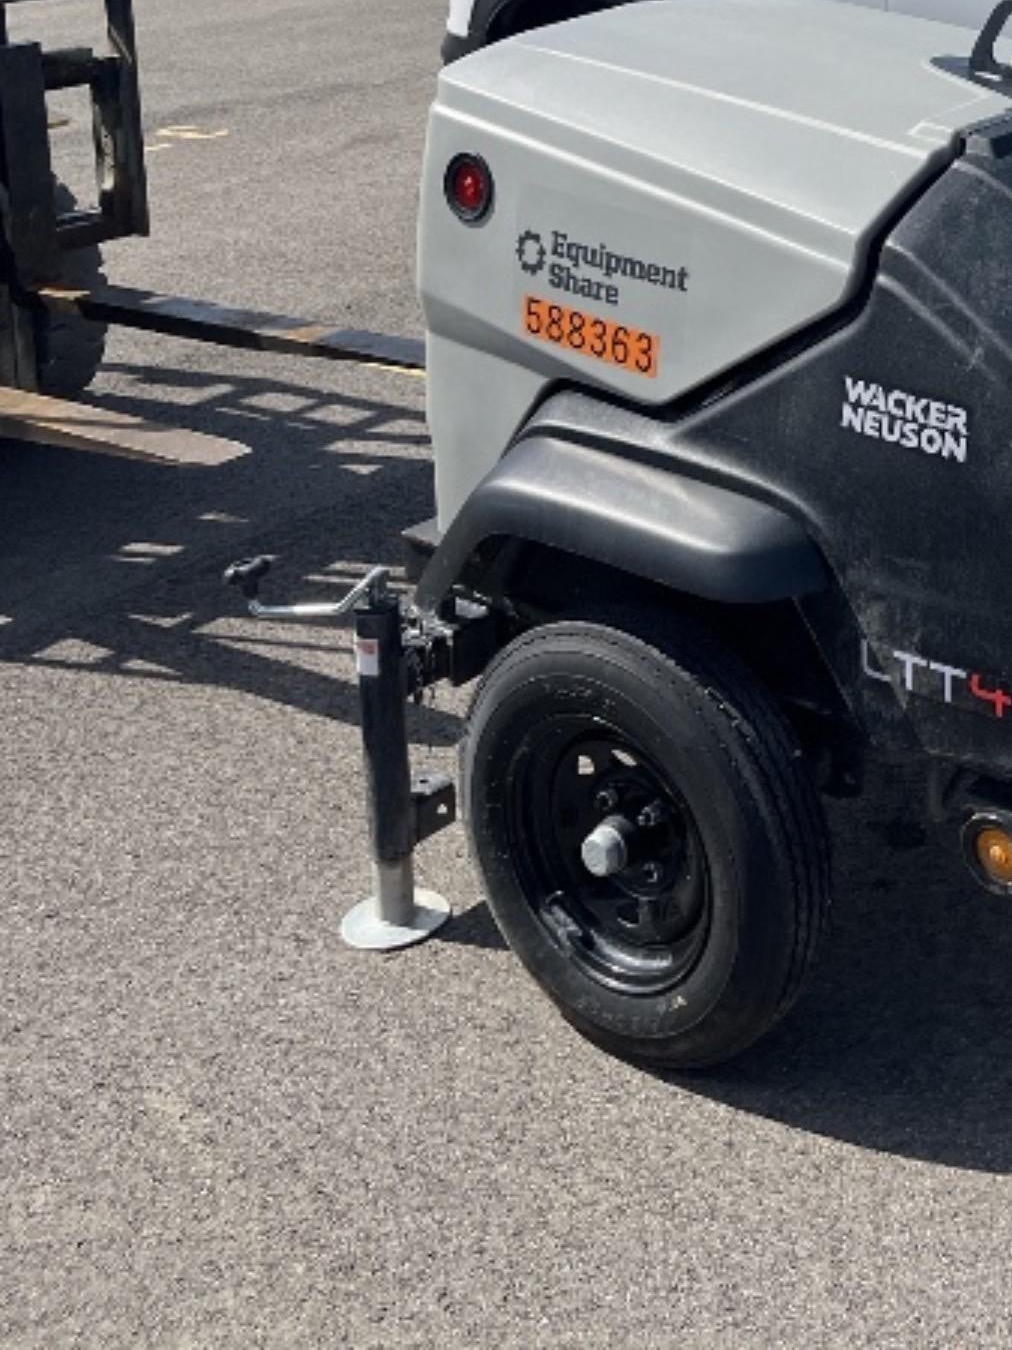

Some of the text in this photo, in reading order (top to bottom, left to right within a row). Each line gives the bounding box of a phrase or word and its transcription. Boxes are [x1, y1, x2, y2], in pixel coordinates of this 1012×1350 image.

[549, 262, 620, 305] Share
[551, 230, 689, 292] Equipment
[526, 297, 653, 373] 588363
[841, 401, 967, 463] NEUSON
[844, 375, 969, 437] WACKER
